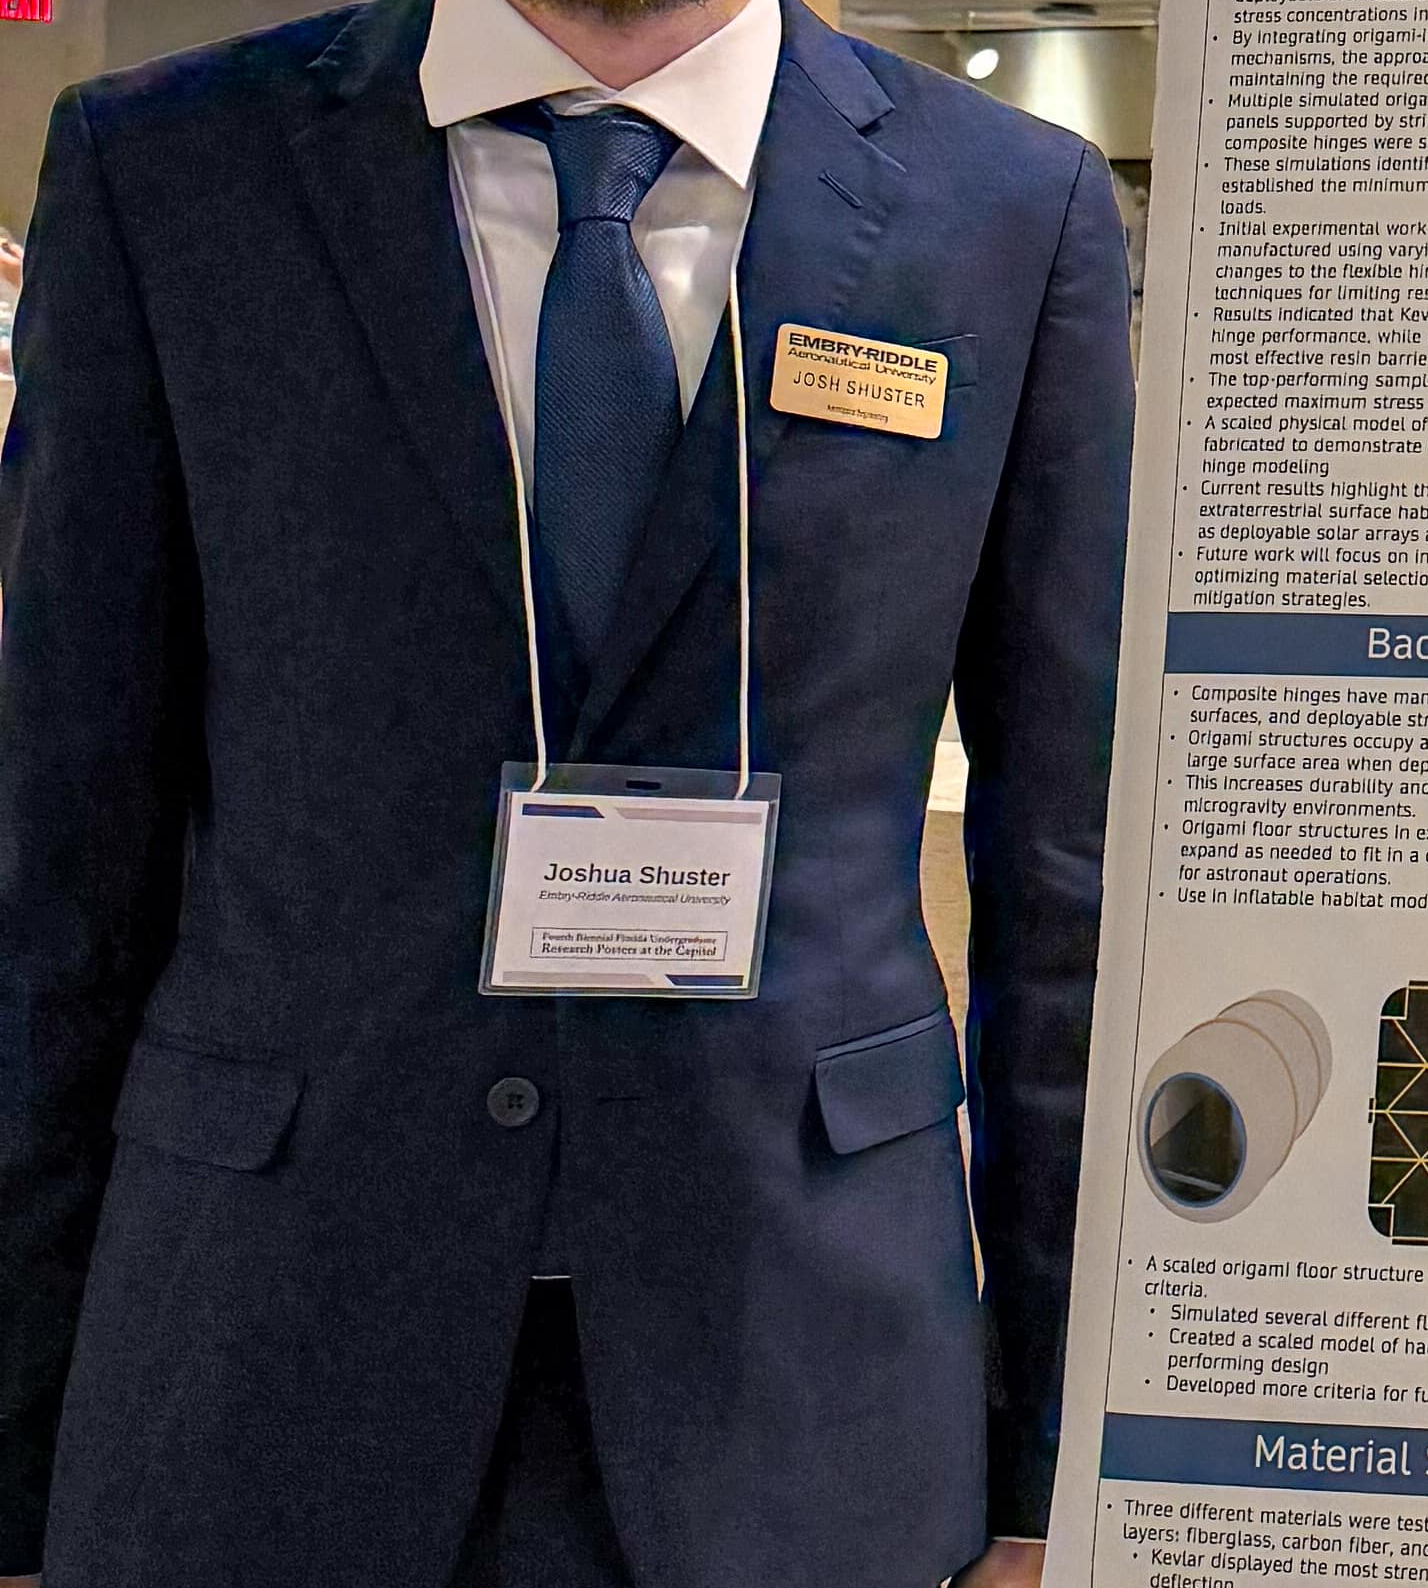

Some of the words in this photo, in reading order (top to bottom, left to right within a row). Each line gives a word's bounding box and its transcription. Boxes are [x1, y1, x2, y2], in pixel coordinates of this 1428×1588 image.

[787, 347, 871, 371] Aeronautical
[875, 363, 937, 385] University
[789, 333, 938, 373] EMBRY-RIDDLE
[793, 371, 840, 393] JOSH
[846, 380, 926, 409] SHUSTER
[1191, 684, 1278, 704] Composite
[1283, 686, 1341, 707] hinges
[1347, 687, 1388, 704] have
[543, 863, 632, 884] Joshua
[639, 865, 731, 887] Shuster
[538, 890, 610, 902] Embry-Riddle
[680, 895, 731, 906] University
[541, 943, 593, 954] Research
[596, 943, 637, 955] Posters
[655, 944, 672, 956] the
[675, 945, 717, 958] Capitol
[1255, 1434, 1411, 1476] Material
